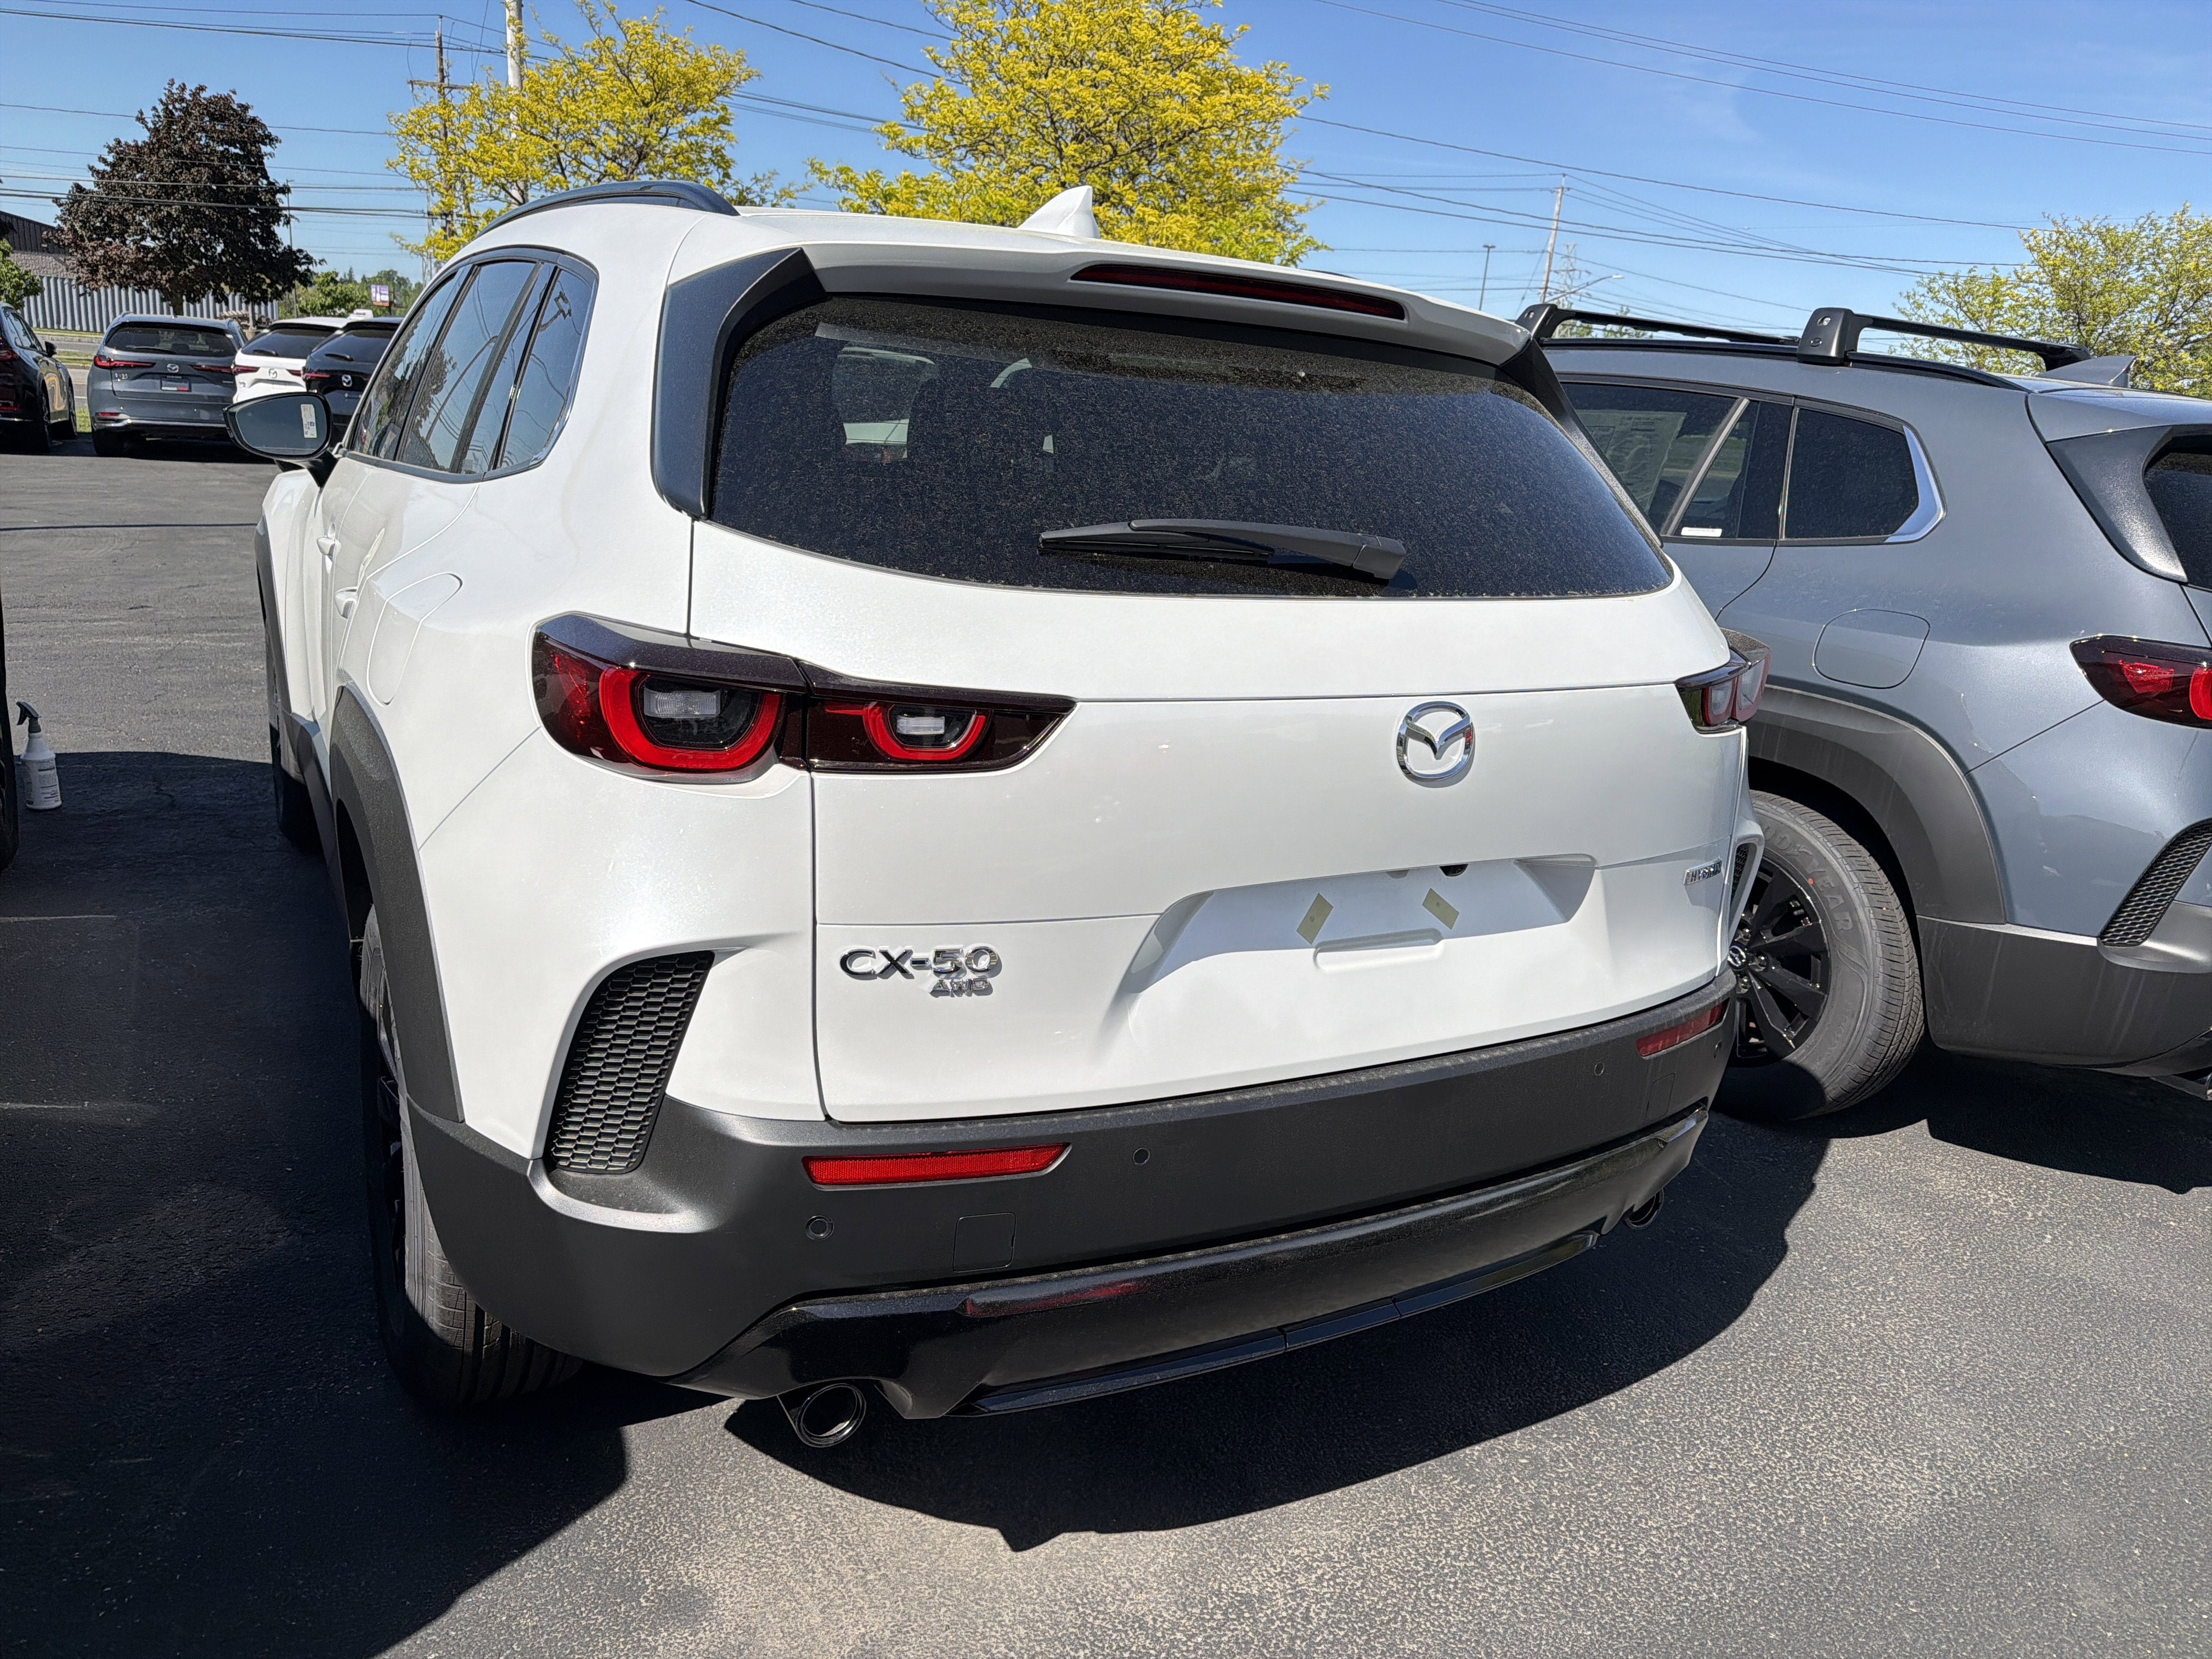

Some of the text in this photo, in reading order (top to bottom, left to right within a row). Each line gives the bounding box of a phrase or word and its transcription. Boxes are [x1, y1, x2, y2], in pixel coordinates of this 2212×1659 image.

[1763, 825, 1853, 932] ODYEAR
[839, 946, 1000, 977] CX-50
[932, 978, 990, 996] AWD
